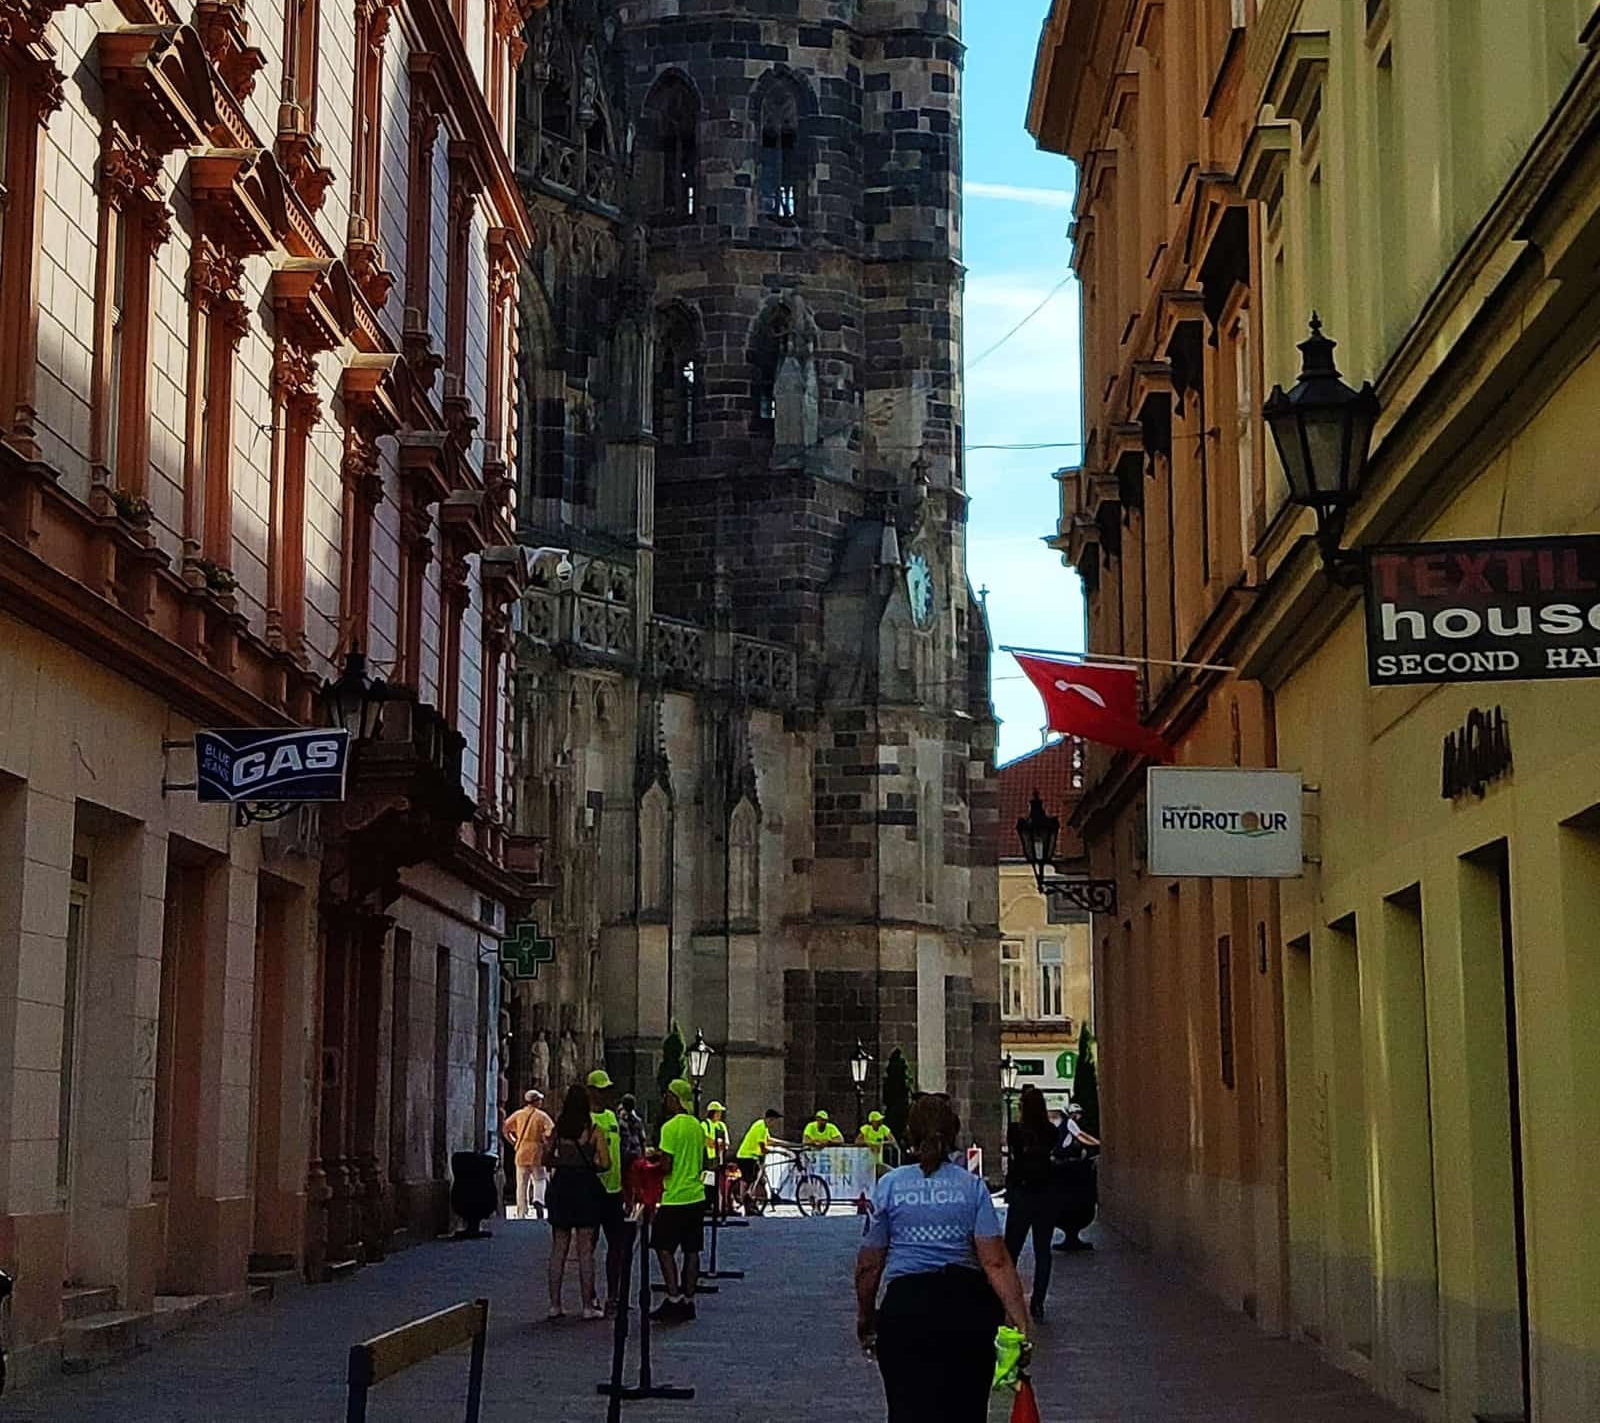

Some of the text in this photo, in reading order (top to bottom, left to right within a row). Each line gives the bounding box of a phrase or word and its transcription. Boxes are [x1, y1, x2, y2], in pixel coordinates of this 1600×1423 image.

[1374, 549, 1597, 596] TEXTIL
[1381, 602, 1600, 641] hous
[1377, 650, 1520, 676] SECOND
[205, 743, 231, 768] BLUE
[232, 740, 339, 786] GAS
[202, 759, 230, 782] JEANS
[1162, 811, 1287, 831] HYDROTOUR
